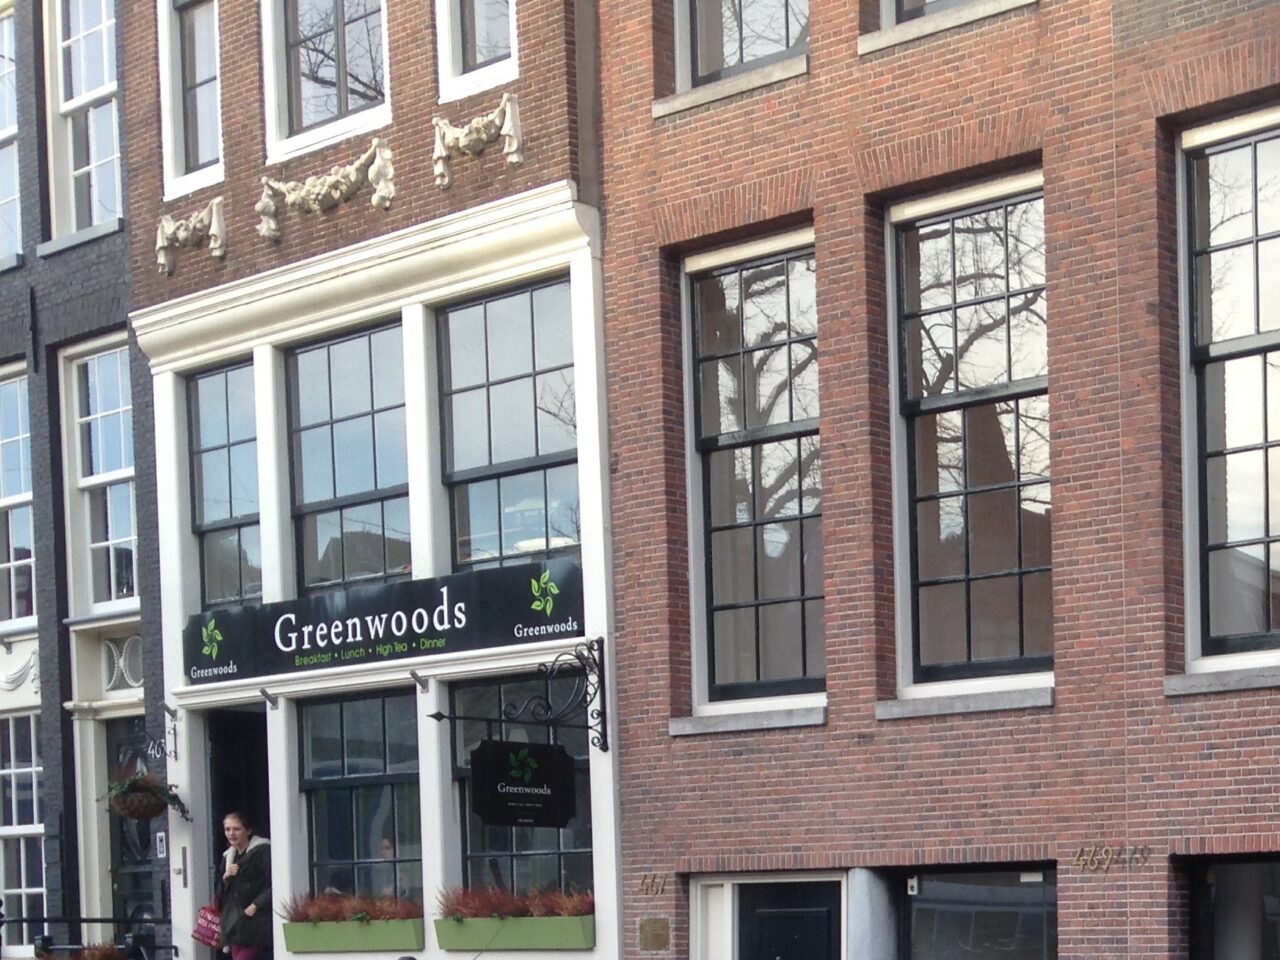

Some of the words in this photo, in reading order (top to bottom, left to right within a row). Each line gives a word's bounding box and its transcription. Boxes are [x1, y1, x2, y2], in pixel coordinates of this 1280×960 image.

[274, 585, 467, 653] Greenwoods
[514, 616, 578, 638] Greenwoods
[295, 652, 332, 667] Breakfast
[341, 647, 366, 660] Lunch
[376, 644, 393, 657] High
[394, 641, 408, 653] Tea
[420, 638, 446, 650] Dinner
[190, 660, 238, 679] Greenwoods
[497, 782, 551, 795] Greenwoods
[1072, 844, 1114, 873] 469
